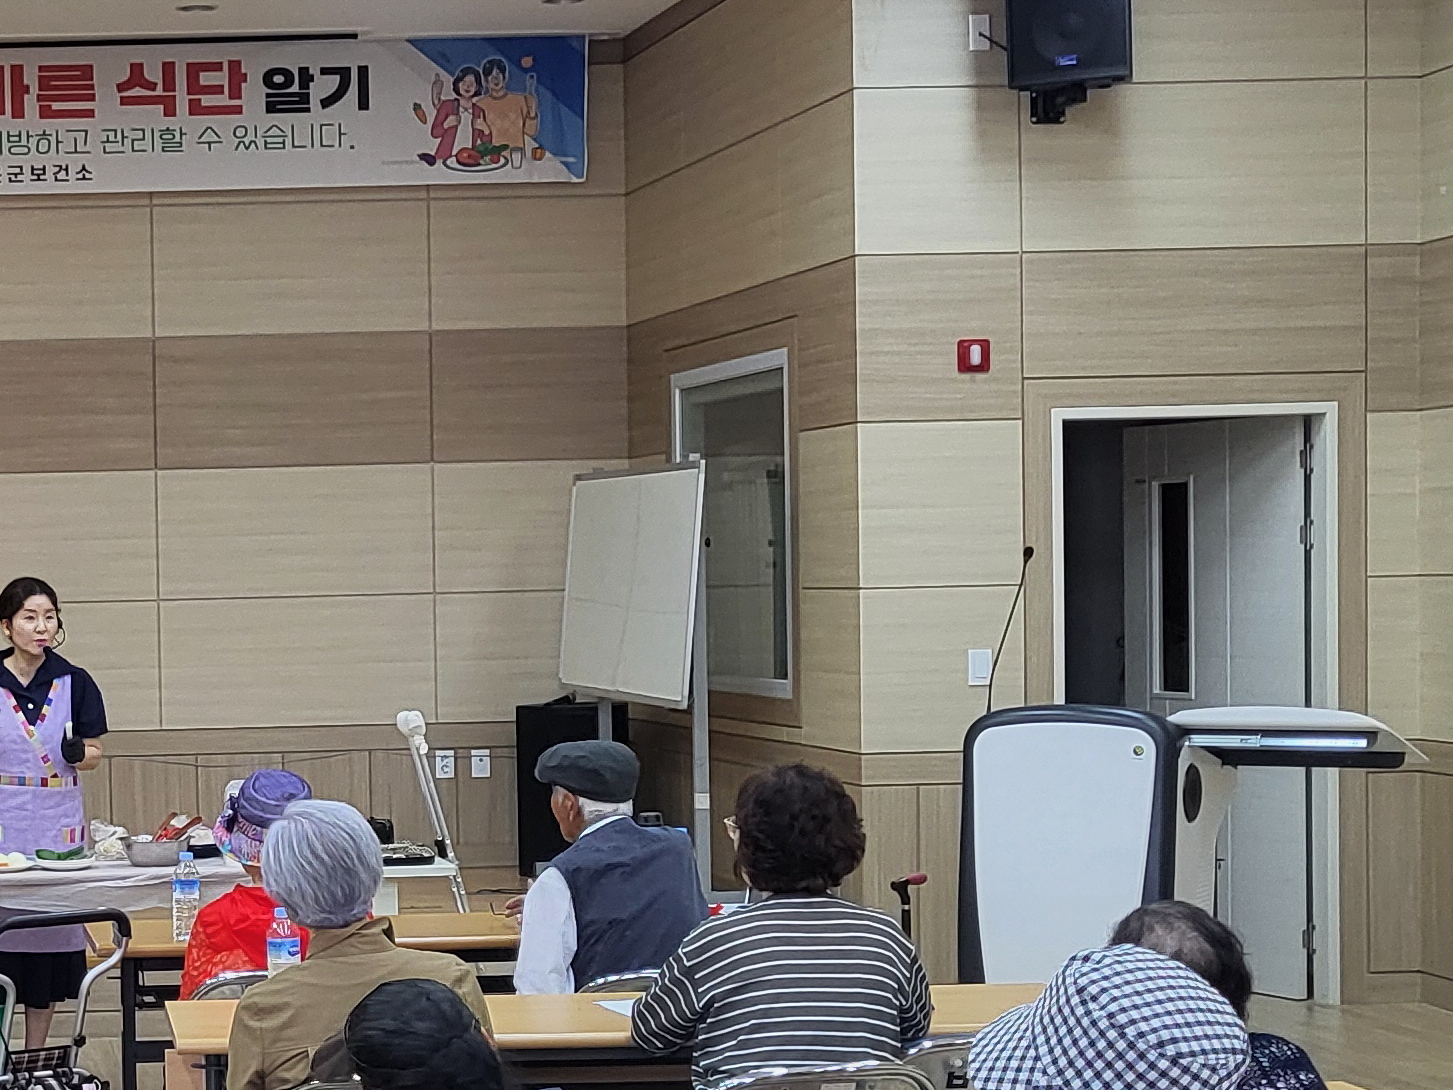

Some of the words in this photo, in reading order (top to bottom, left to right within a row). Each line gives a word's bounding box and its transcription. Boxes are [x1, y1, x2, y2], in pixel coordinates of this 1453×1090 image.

[116, 59, 248, 117] 식단
[262, 65, 370, 114] 알기
[100, 126, 187, 154] 관리할
[196, 125, 224, 152] 수
[233, 122, 355, 151] 있습니다.
